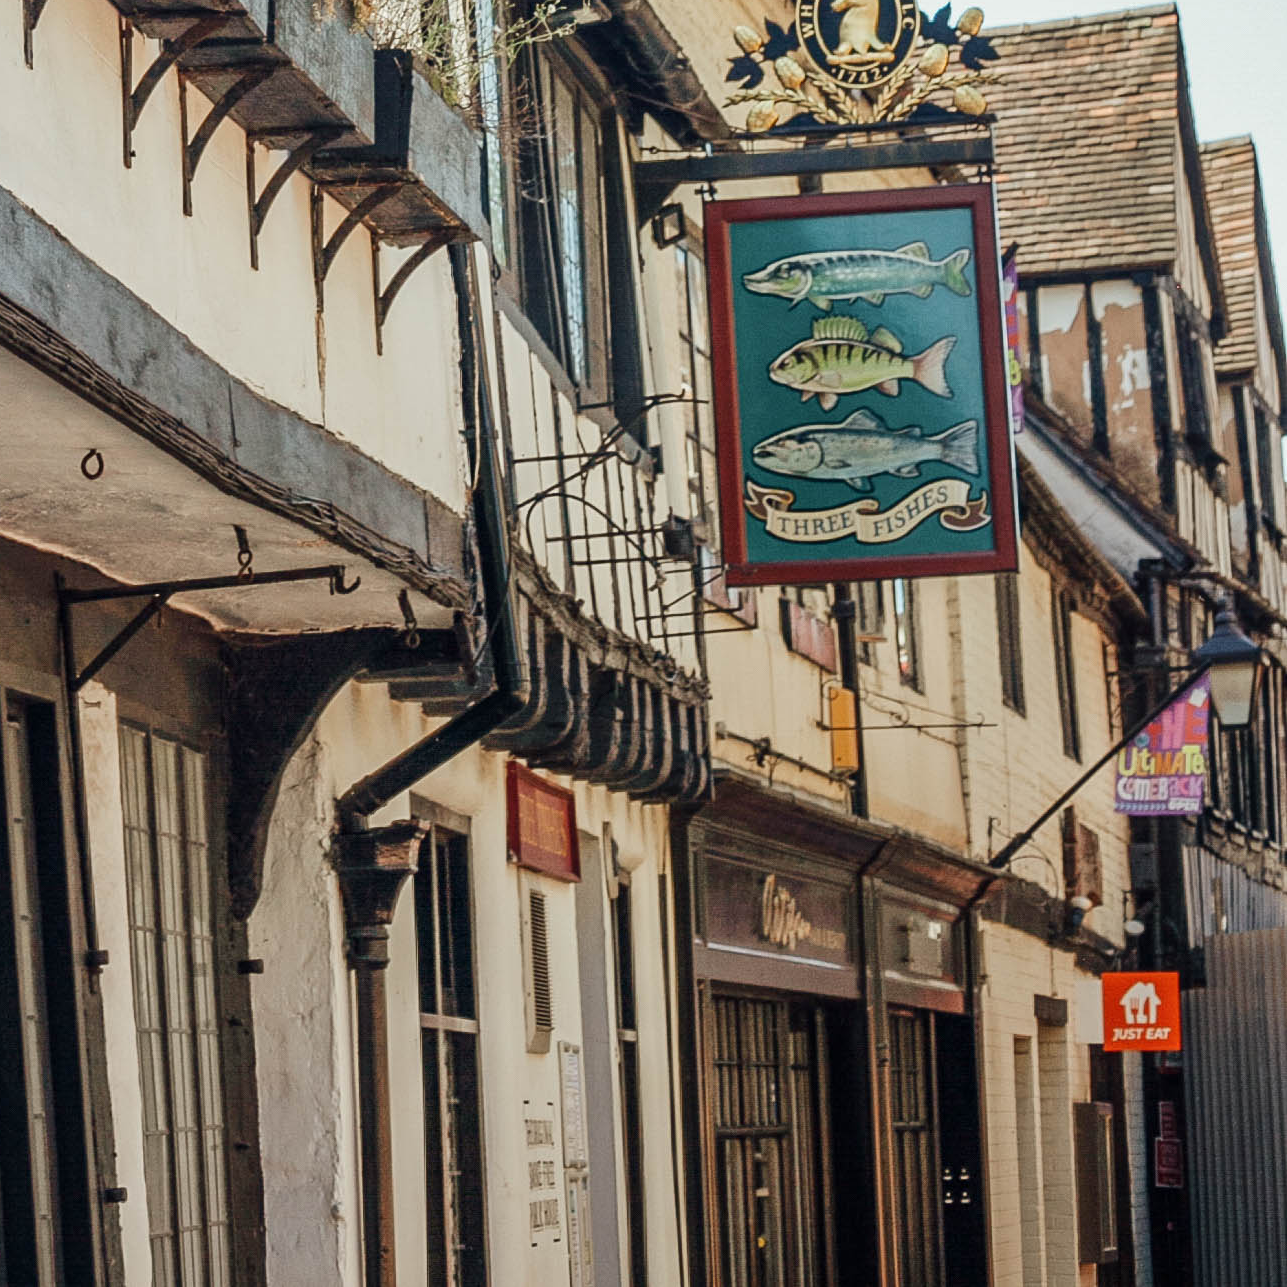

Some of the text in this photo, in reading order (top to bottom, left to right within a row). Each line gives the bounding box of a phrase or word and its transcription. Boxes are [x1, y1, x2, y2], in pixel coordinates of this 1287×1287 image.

[837, 67, 883, 84] 1742
[776, 485, 949, 538] THREE FISHES
[1112, 1027, 1171, 1042] JUST EAT
